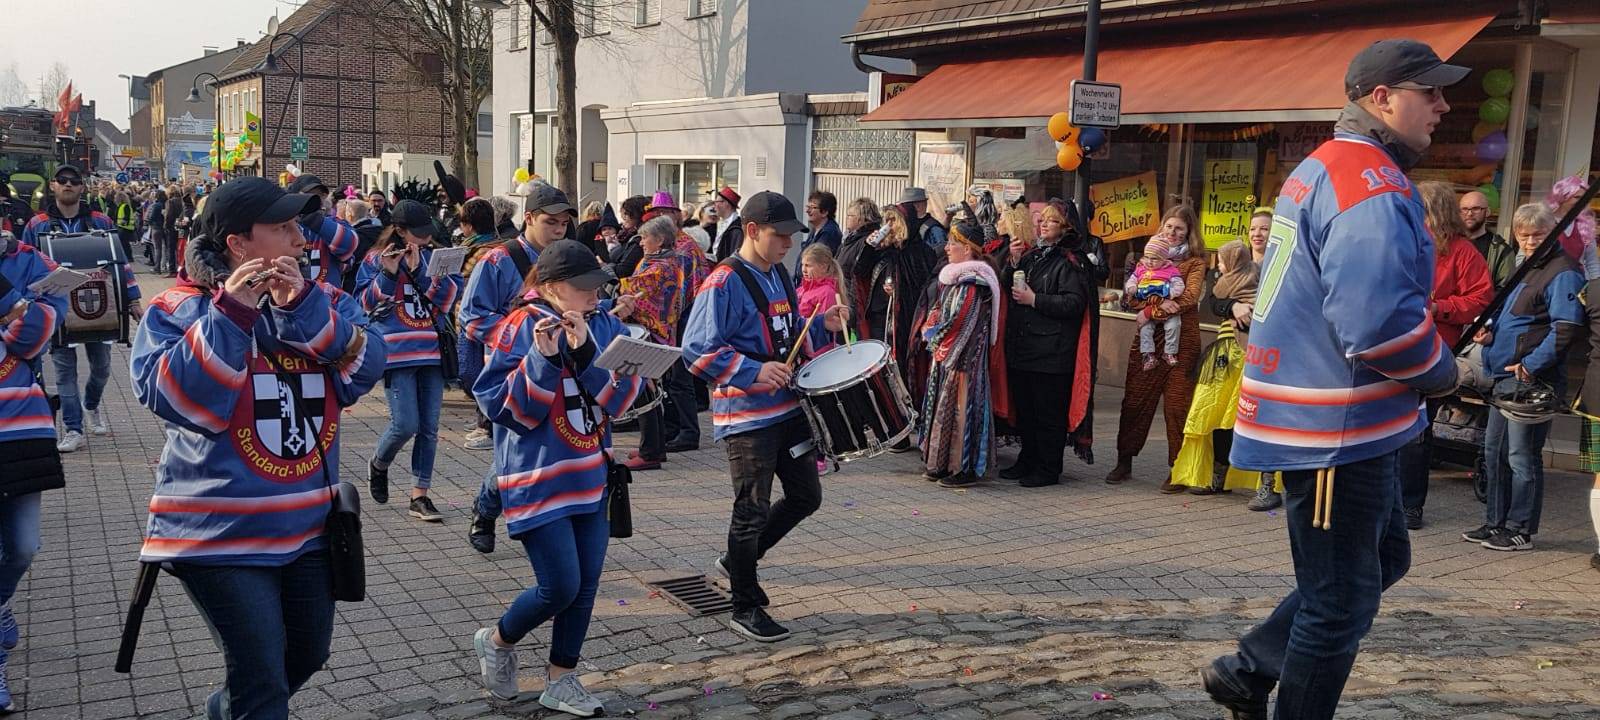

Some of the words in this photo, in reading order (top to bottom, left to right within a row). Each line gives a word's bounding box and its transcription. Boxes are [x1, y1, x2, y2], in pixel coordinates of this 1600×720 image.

[1081, 88, 1115, 98] Wochenmarkt
[1075, 100, 1096, 110] Freitags
[1210, 163, 1249, 192] frische
[295, 422, 338, 477] Musizug
